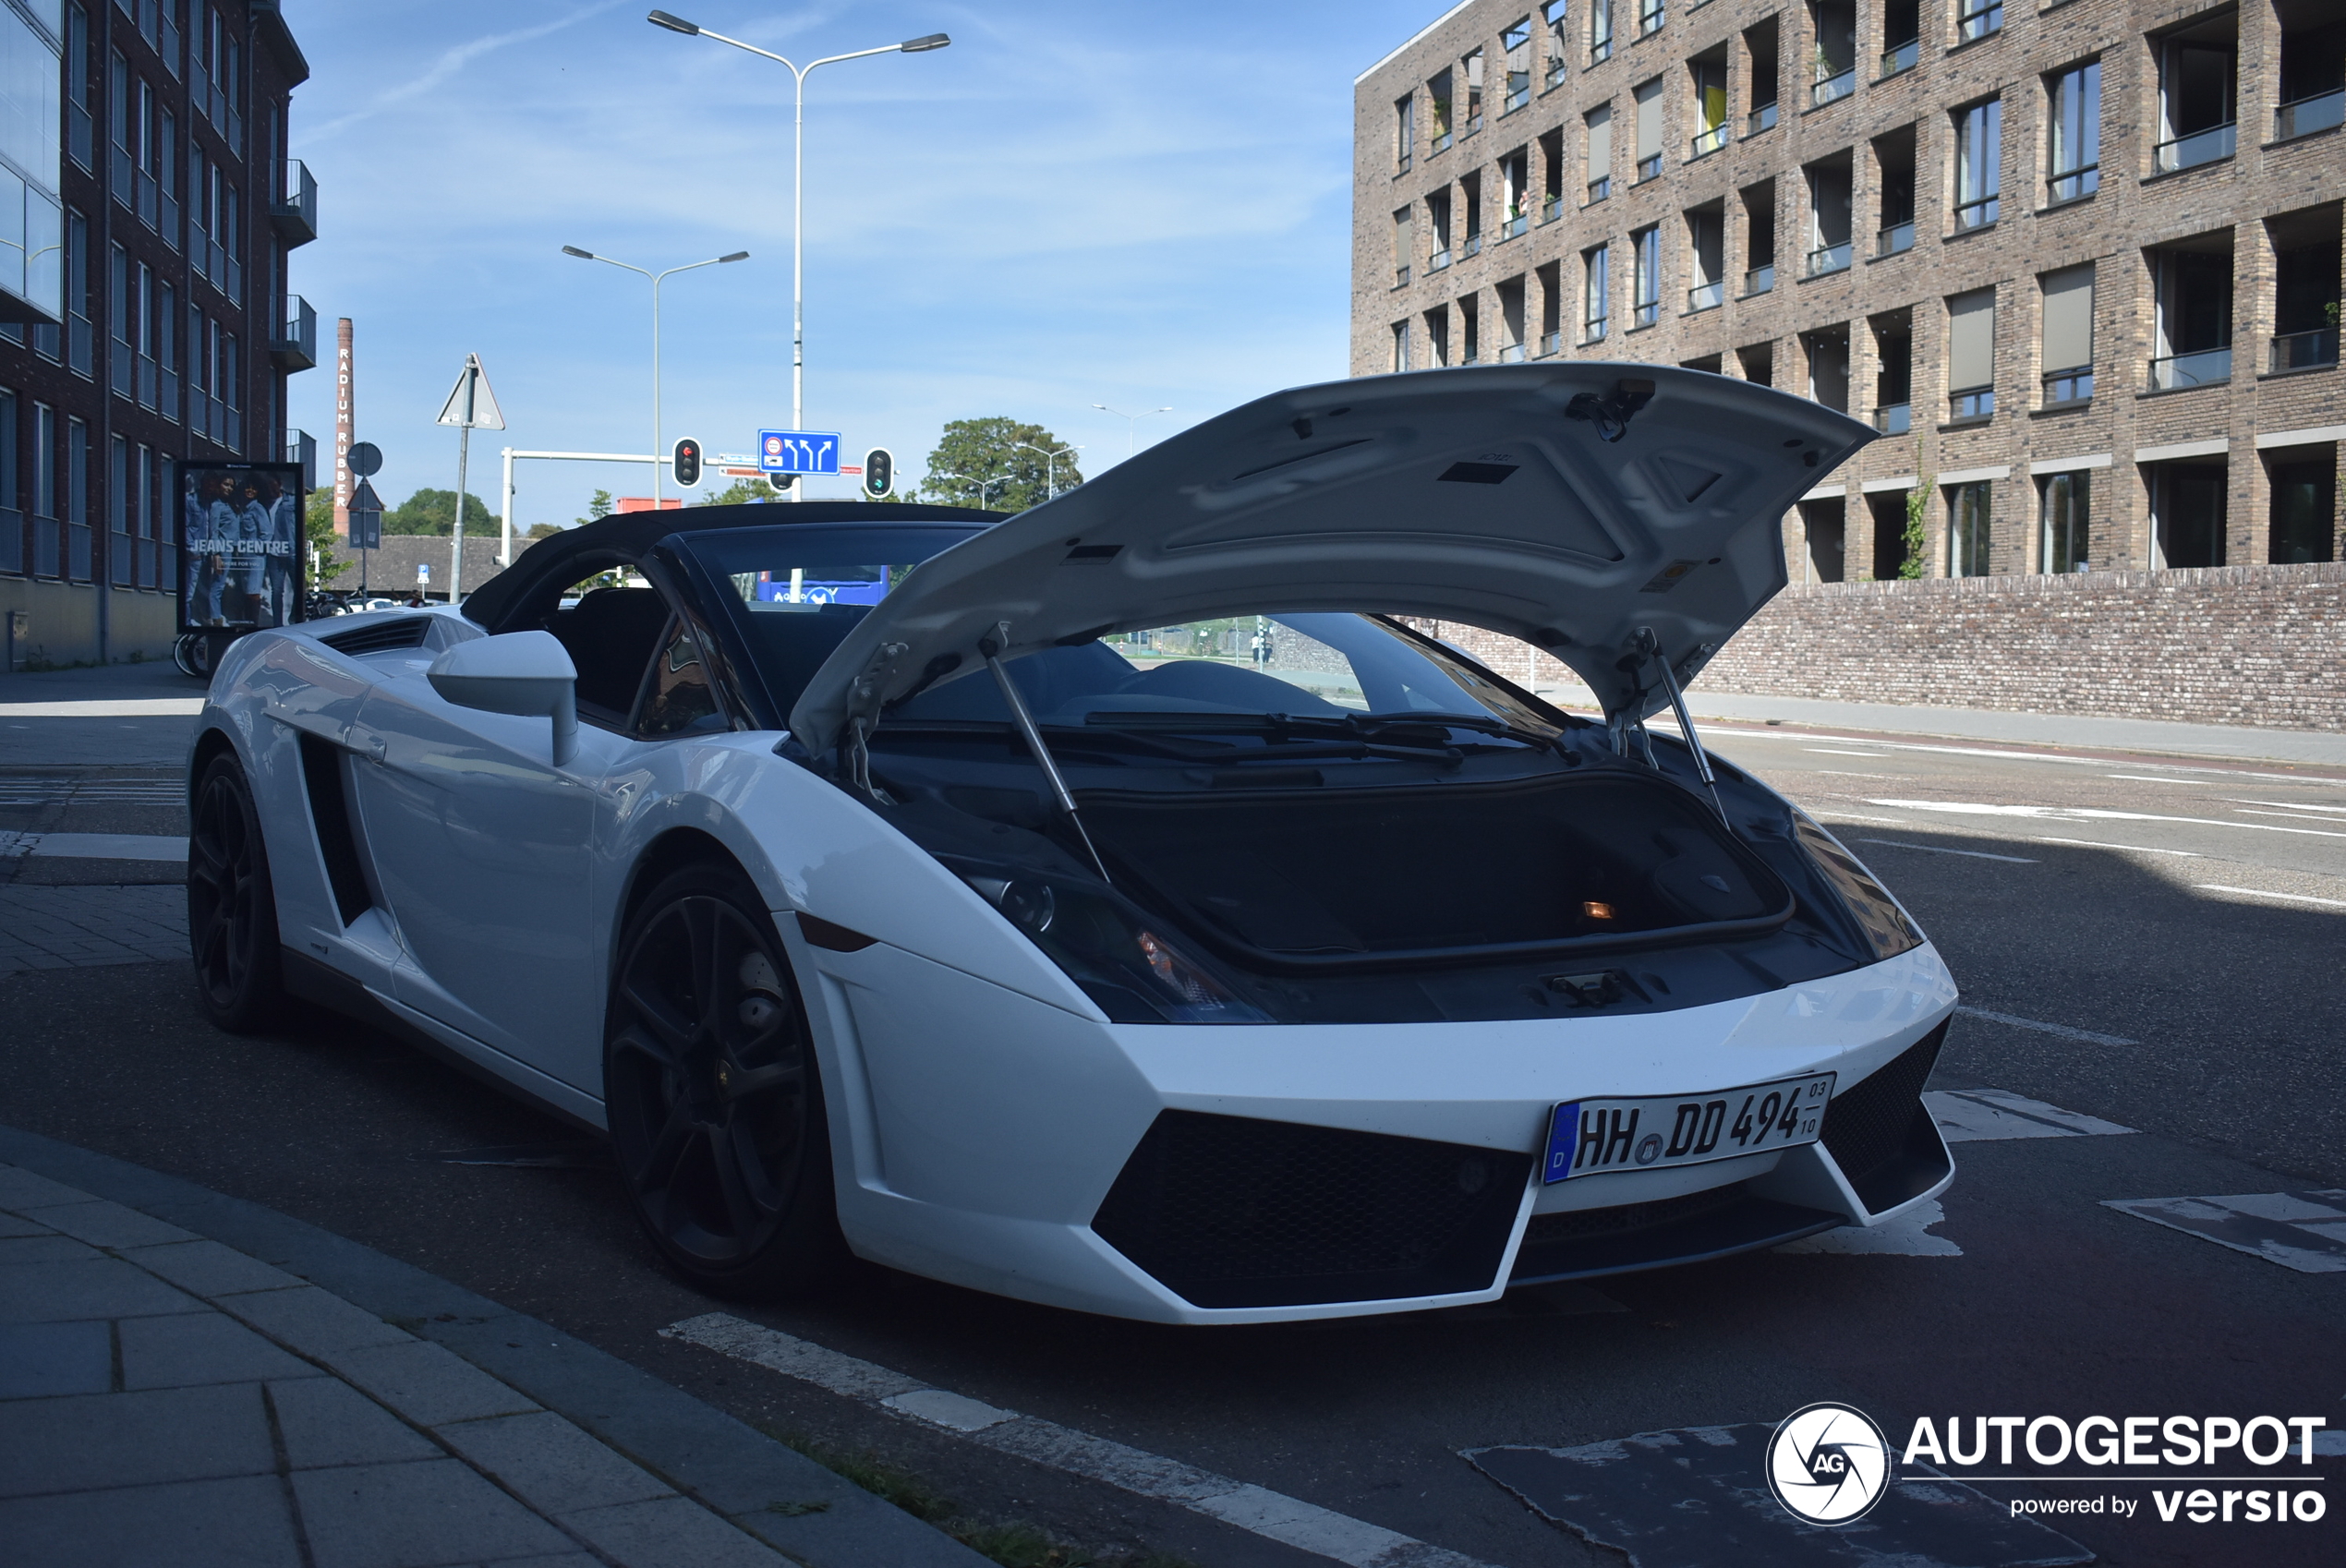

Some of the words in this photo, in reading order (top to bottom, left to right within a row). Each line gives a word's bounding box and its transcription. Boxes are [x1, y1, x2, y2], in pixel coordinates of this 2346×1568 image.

[338, 348, 348, 423] RADIUM
[337, 432, 346, 506] RUBBER
[190, 539, 234, 553] JEANS
[237, 540, 289, 554] CENTRE
[1808, 1080, 1827, 1097] 03
[1574, 1107, 1639, 1169] HH
[1664, 1099, 1727, 1158] DD
[1730, 1087, 1802, 1147] 494
[1800, 1118, 1816, 1135] 10
[1553, 1152, 1563, 1168] D
